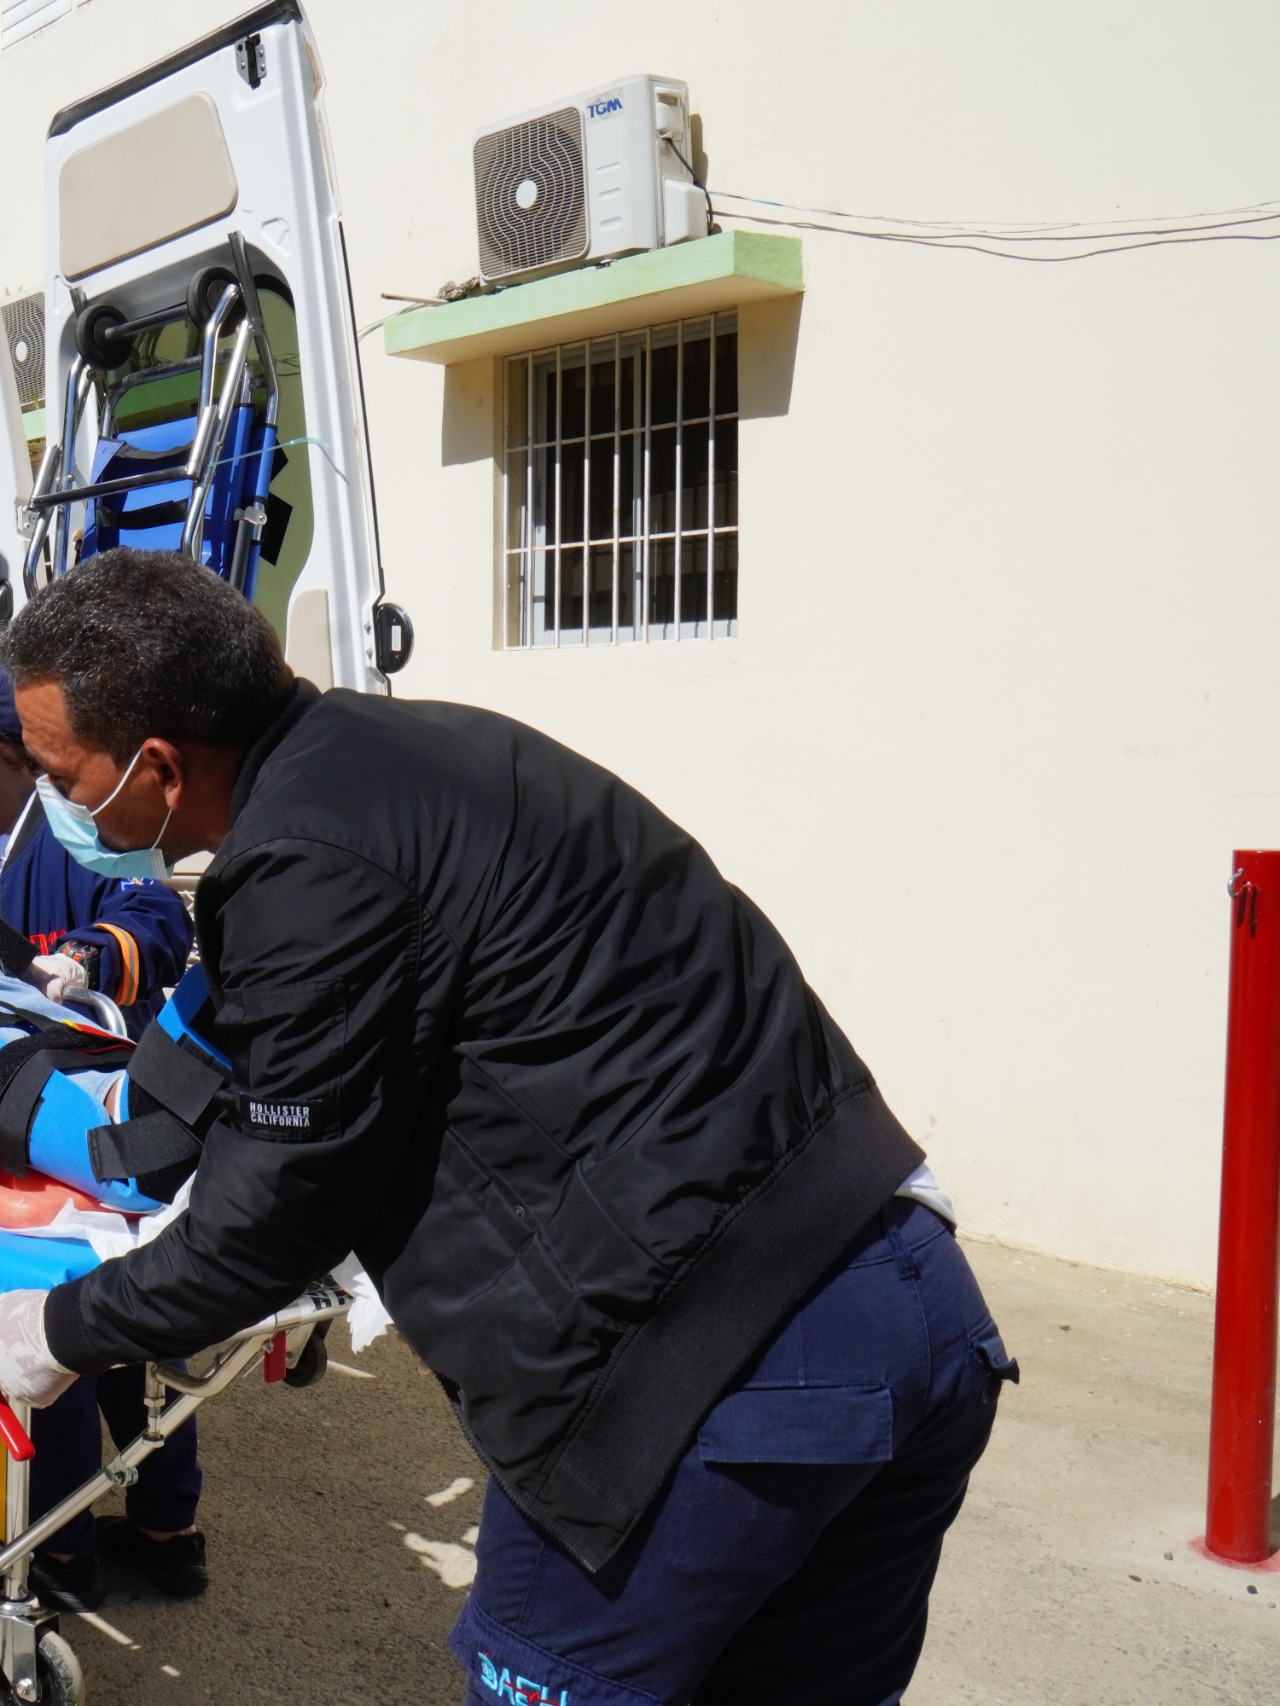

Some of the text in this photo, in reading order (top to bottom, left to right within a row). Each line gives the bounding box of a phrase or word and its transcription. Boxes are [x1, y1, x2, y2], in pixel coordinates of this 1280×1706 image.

[587, 98, 623, 118] TGM
[250, 1102, 309, 1117] HOLLISTER
[251, 1112, 310, 1127] CALIFORNIA
